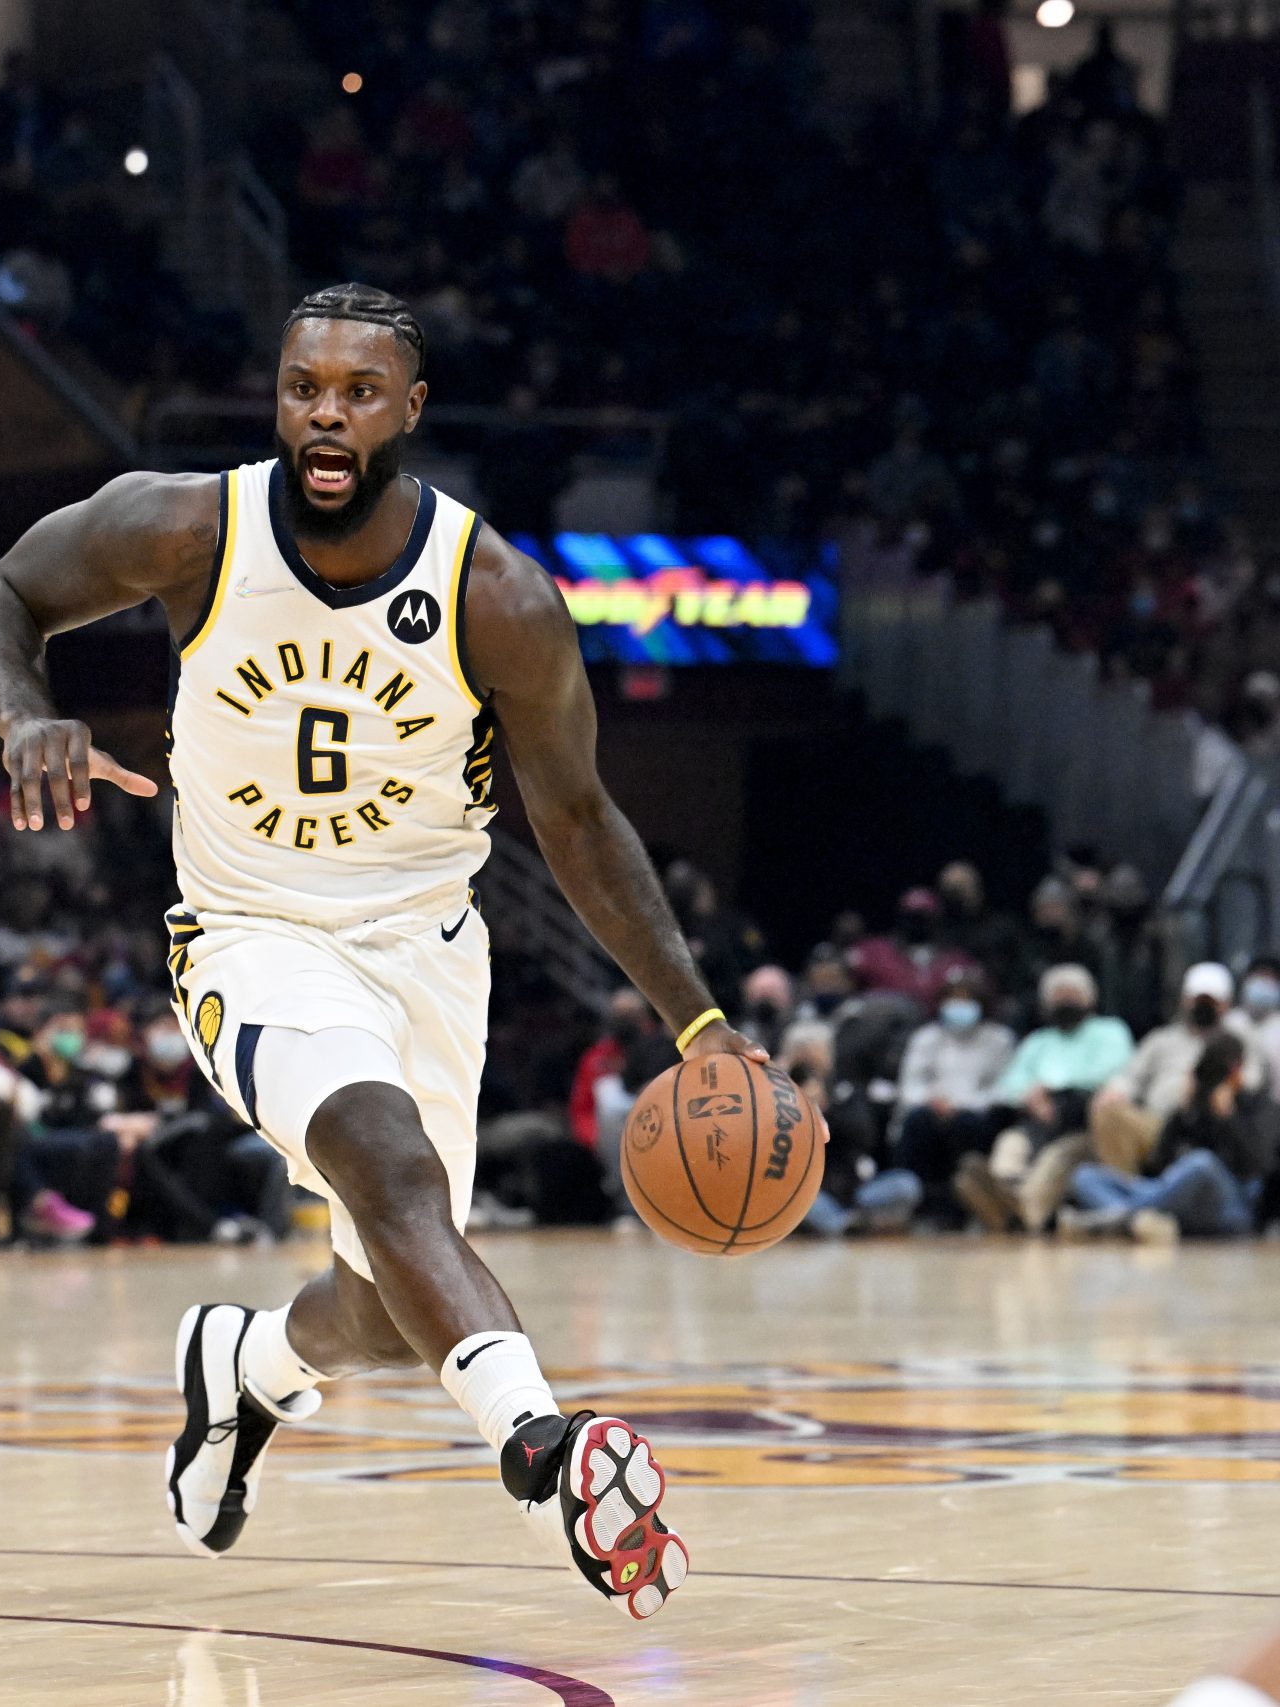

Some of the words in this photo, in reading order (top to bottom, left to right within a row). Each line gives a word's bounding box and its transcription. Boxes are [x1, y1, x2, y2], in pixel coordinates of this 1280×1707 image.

[214, 640, 437, 741] INDIANA
[295, 704, 351, 795] 6
[227, 776, 417, 850] PACERS
[763, 1064, 803, 1180] Wilson
